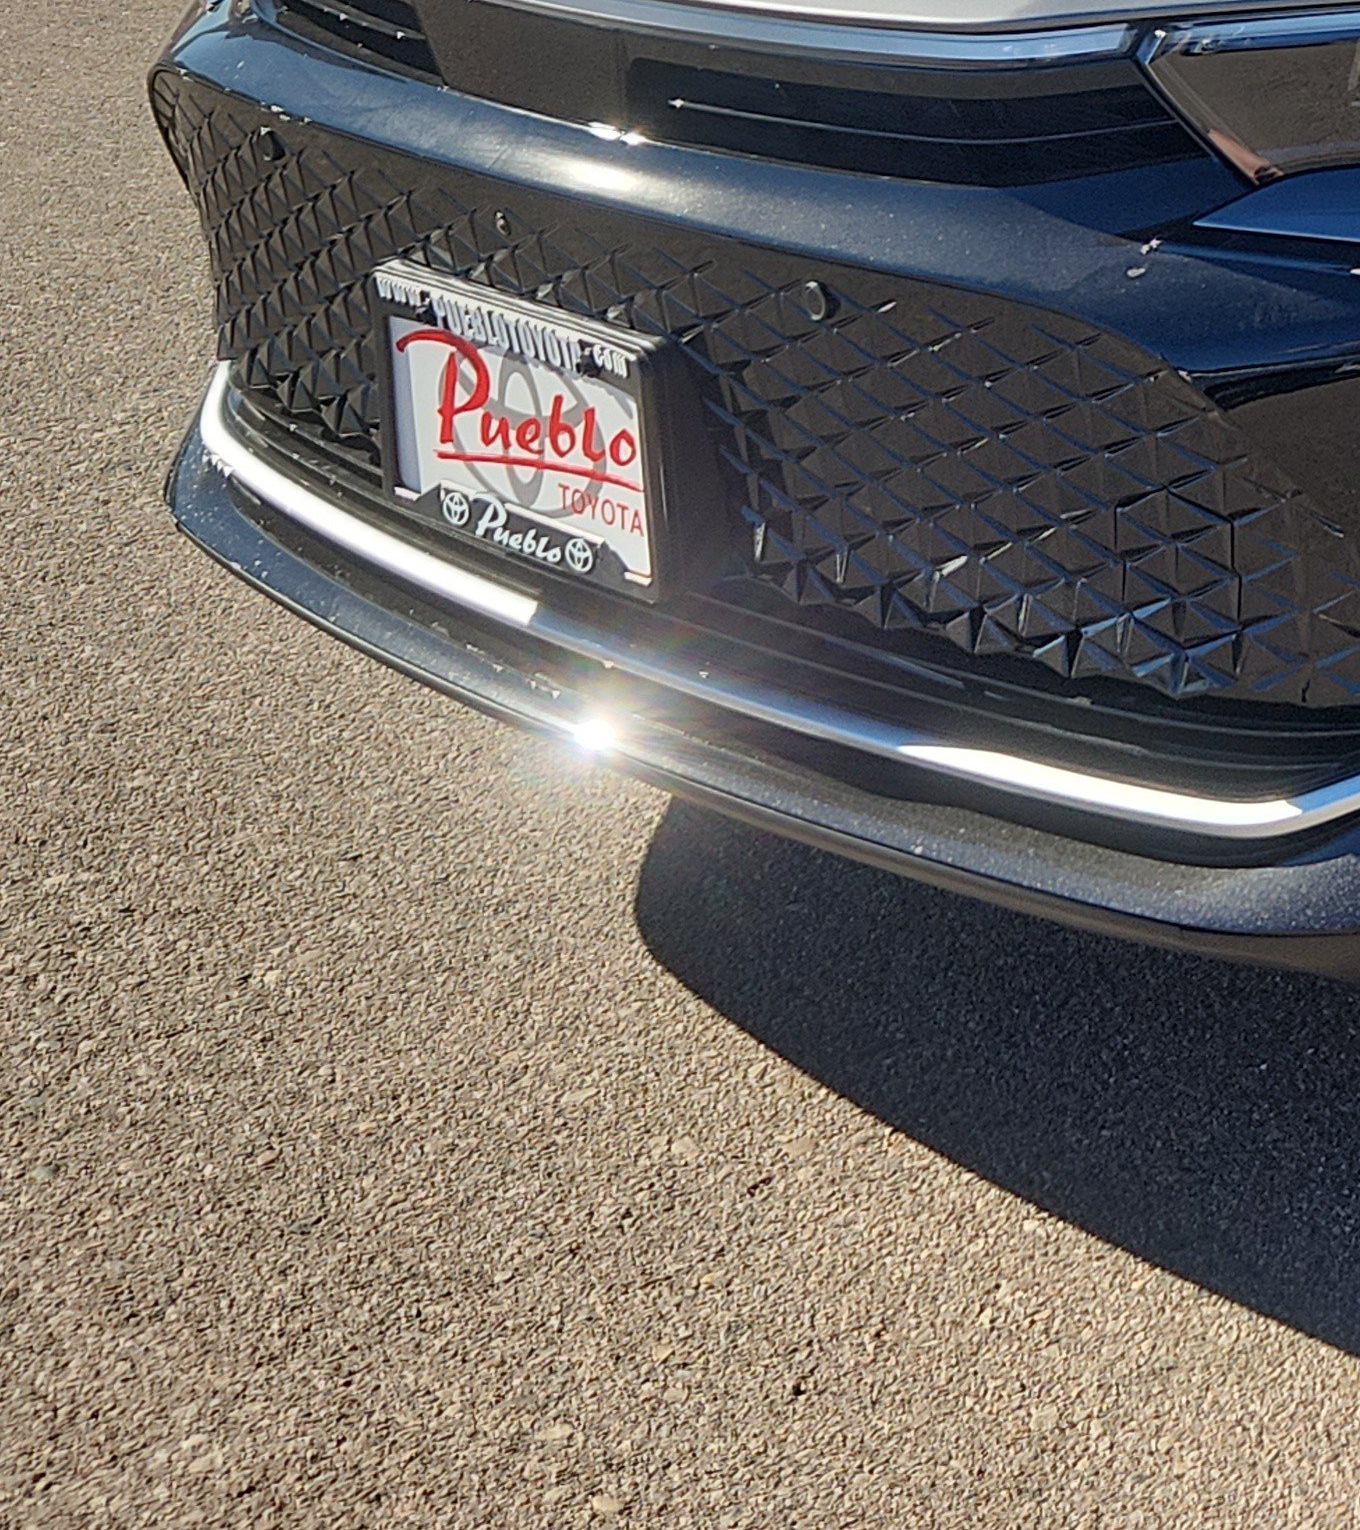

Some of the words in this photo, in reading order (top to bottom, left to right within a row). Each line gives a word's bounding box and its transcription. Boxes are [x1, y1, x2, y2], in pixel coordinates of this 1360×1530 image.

[396, 329, 637, 466] Pueblo
[472, 492, 563, 563] Pueblo
[558, 482, 645, 538] TOYOTA
